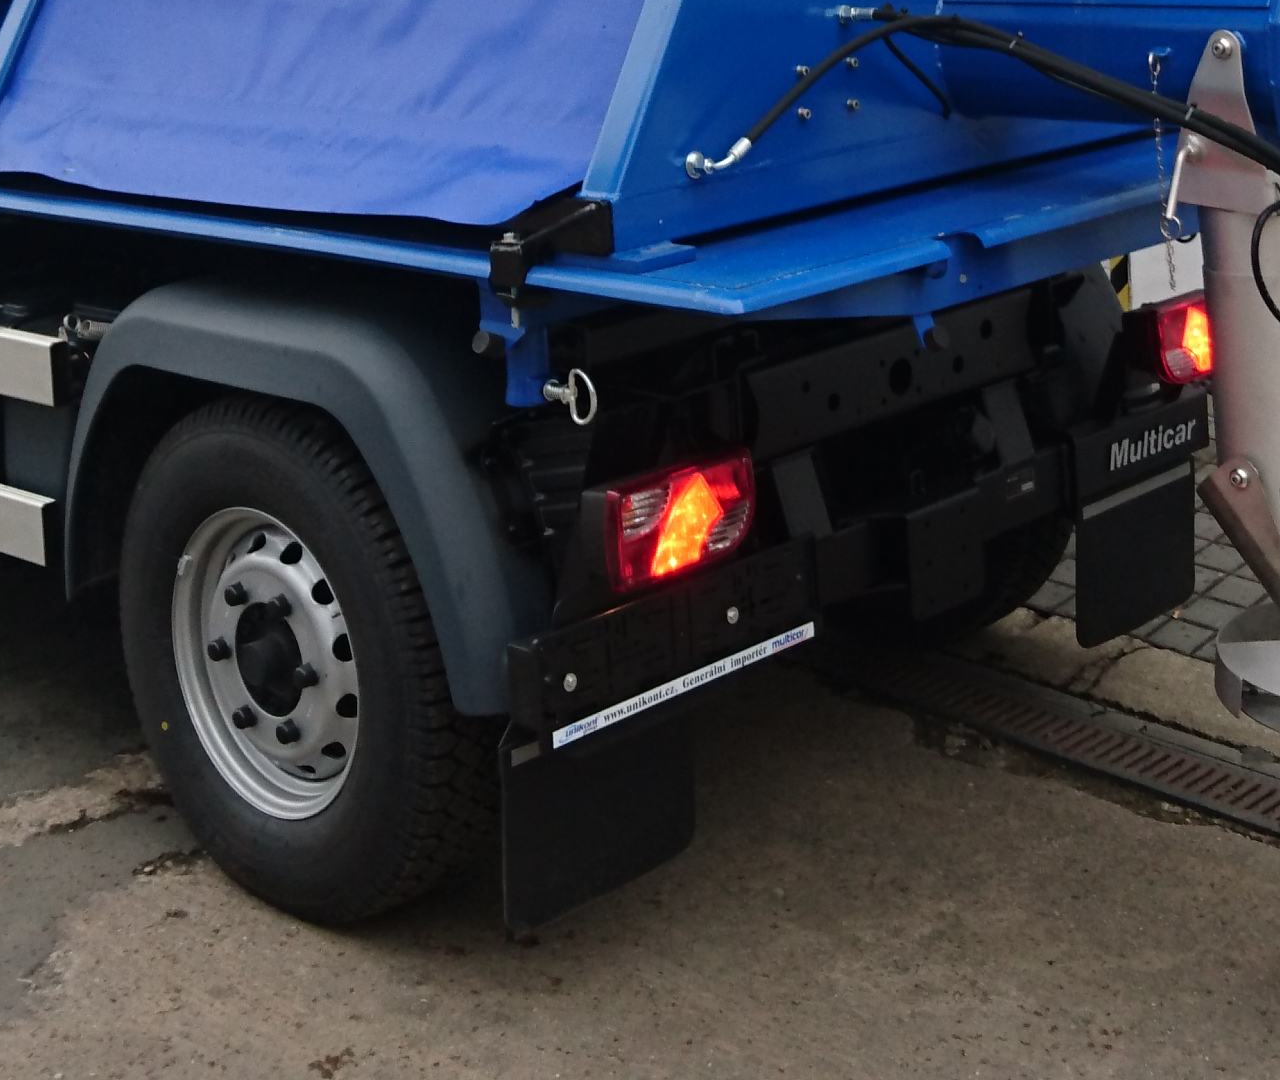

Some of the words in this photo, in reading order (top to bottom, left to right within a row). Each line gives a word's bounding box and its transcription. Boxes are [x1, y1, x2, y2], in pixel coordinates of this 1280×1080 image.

[1109, 418, 1197, 472] Multicar
[682, 660, 727, 689] Generální
[730, 644, 768, 668] importér
